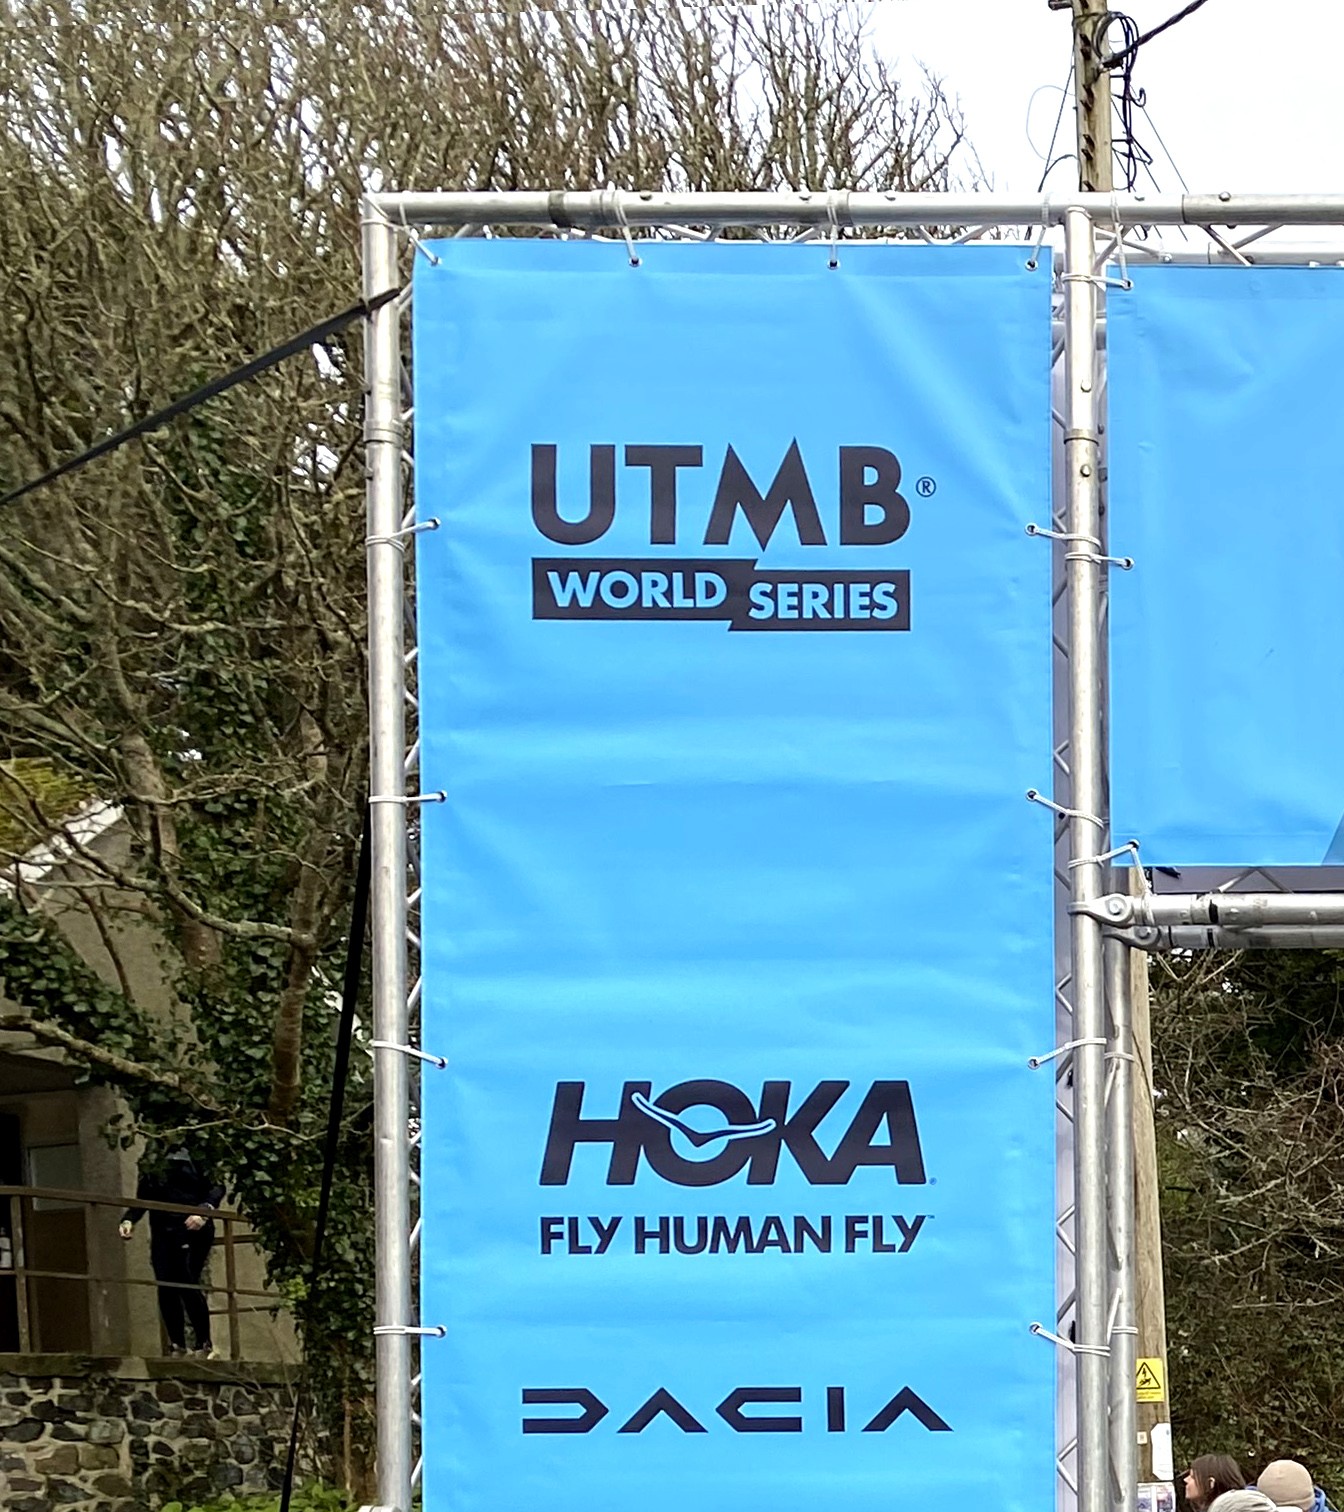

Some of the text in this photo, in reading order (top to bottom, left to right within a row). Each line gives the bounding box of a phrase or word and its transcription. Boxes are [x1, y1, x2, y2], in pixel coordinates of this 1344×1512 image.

[547, 570, 899, 620] WORLD SERIES
[539, 1078, 928, 1187] HOKA
[540, 1214, 928, 1255] FLY HUMAN FLY
[522, 1386, 954, 1434] DACIA
